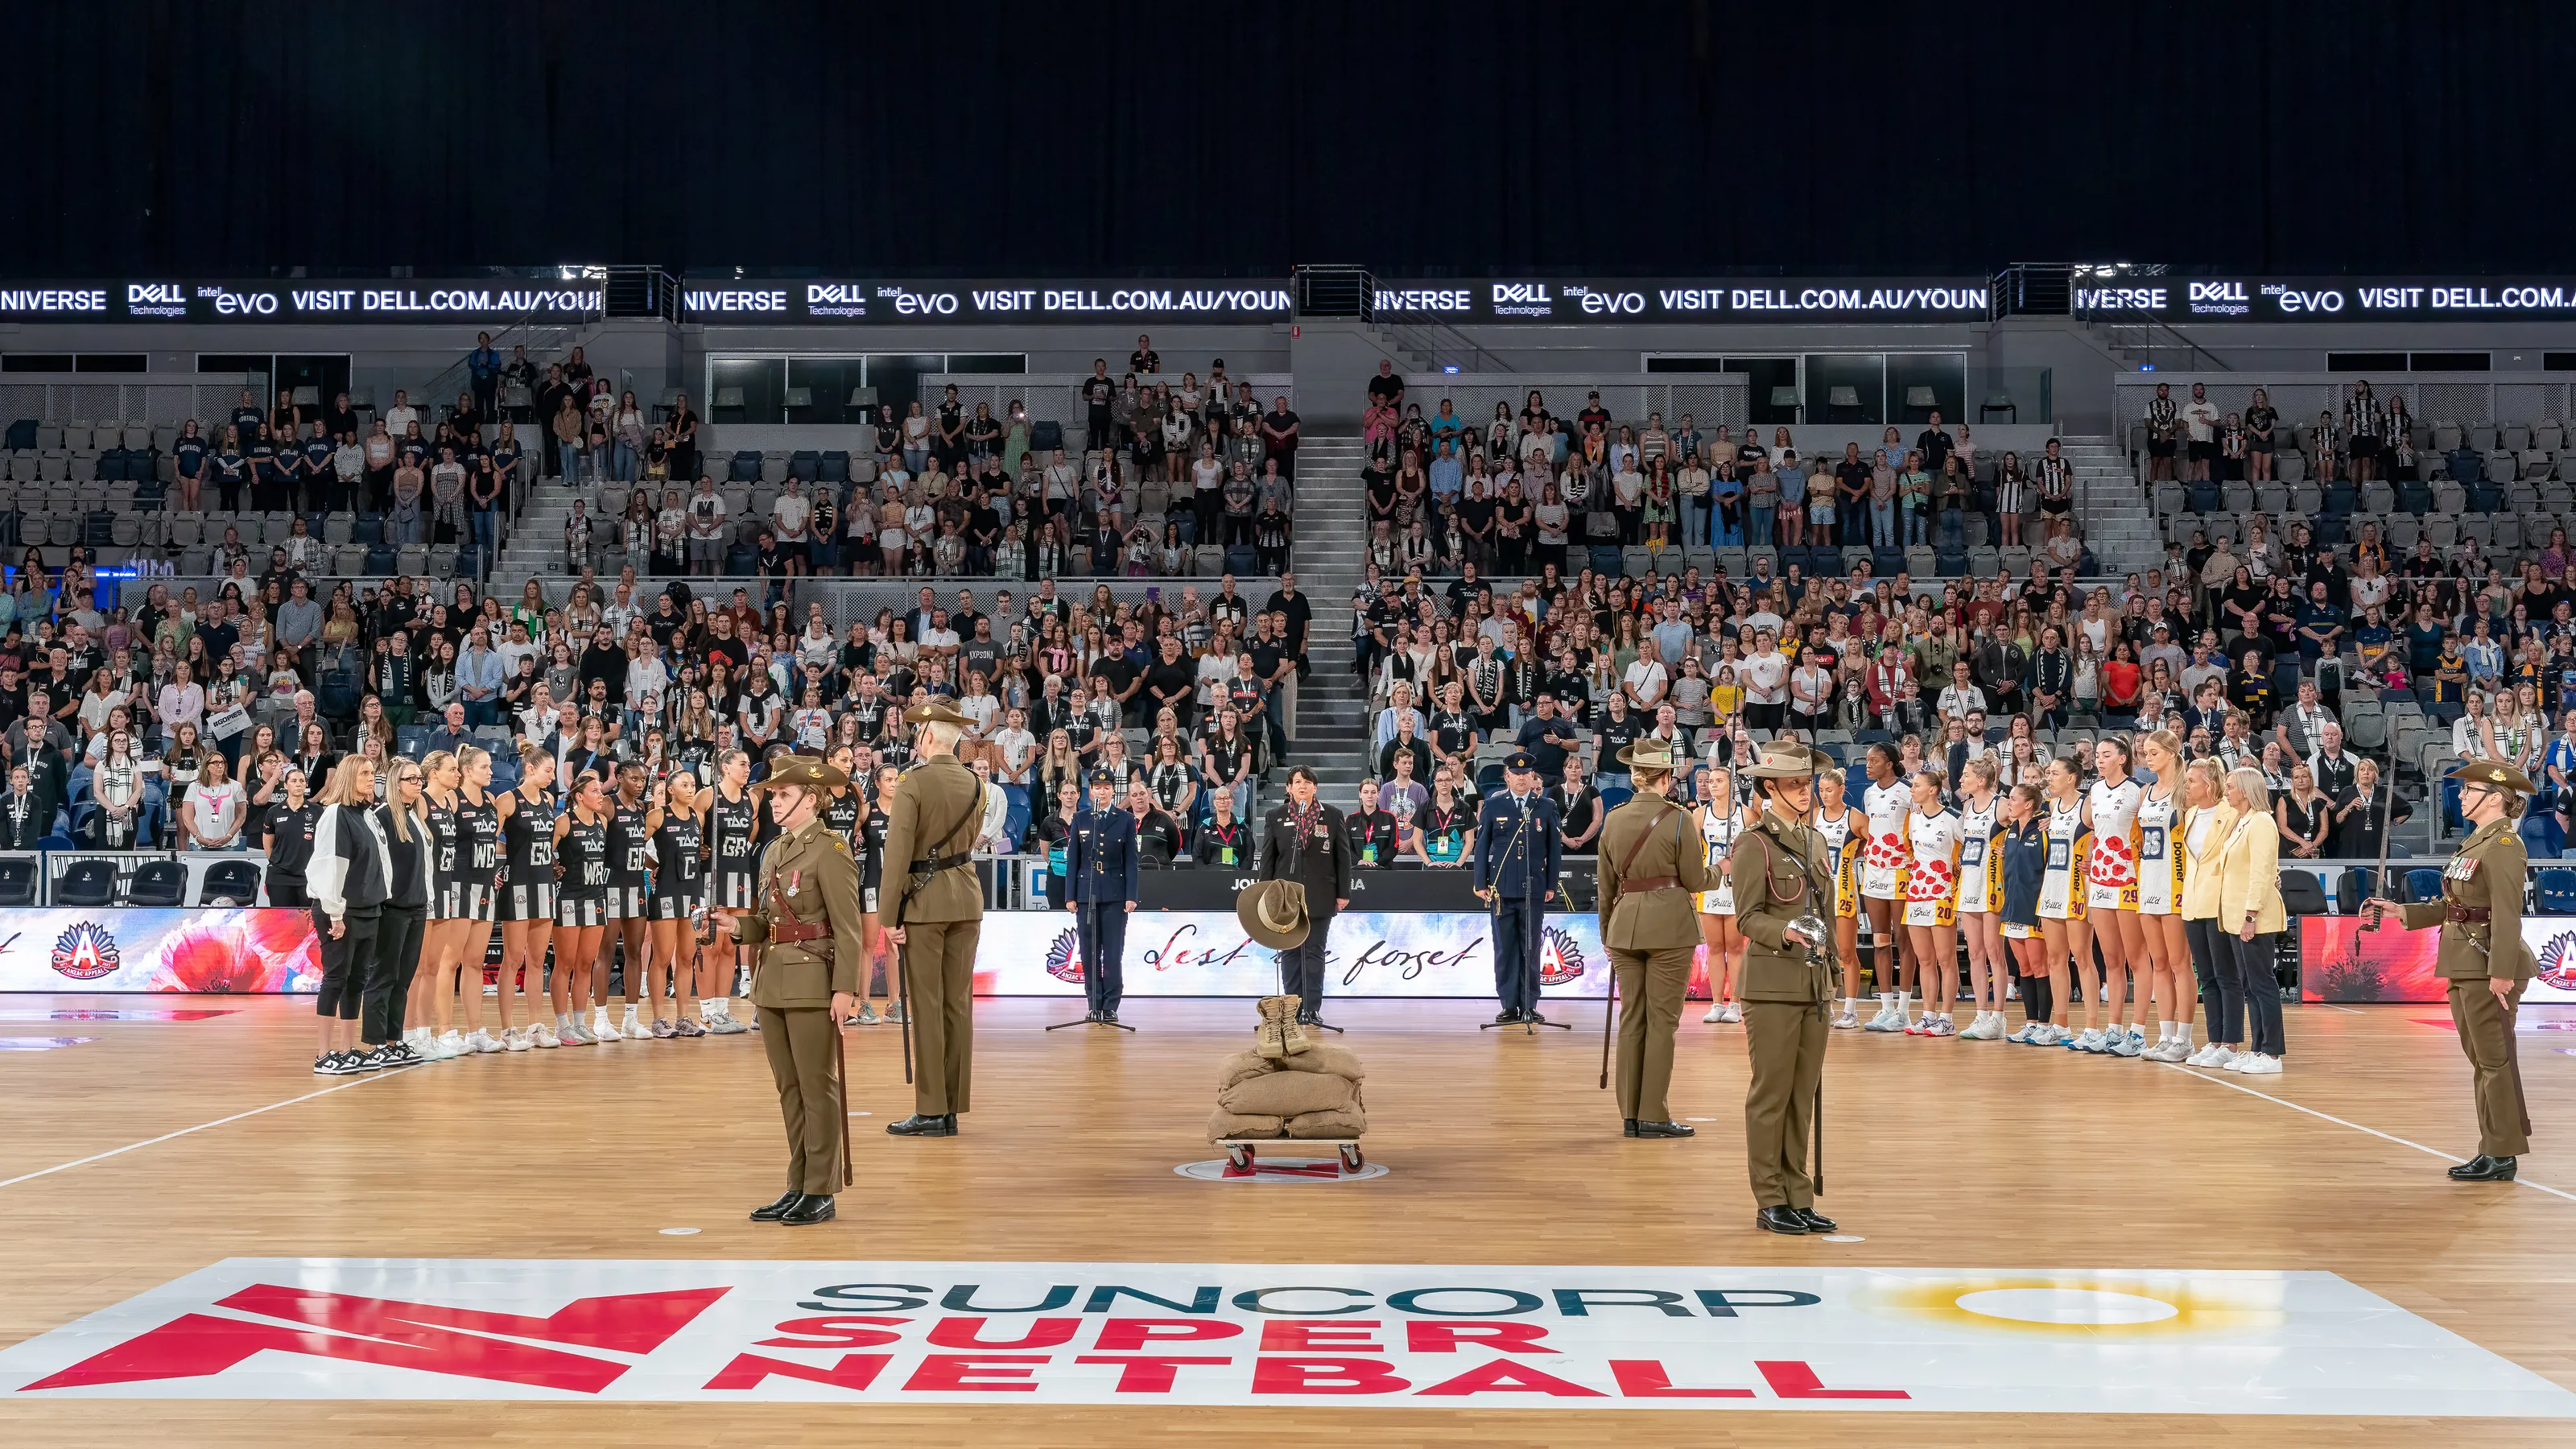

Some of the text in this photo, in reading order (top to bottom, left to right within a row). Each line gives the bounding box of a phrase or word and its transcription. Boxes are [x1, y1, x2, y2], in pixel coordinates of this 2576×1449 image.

[128, 284, 186, 303] DELL
[197, 286, 221, 297] intel
[807, 284, 865, 303] DELL
[877, 287, 902, 298] intel
[1492, 283, 1552, 302] DELL
[1563, 286, 1588, 297] intel
[2190, 282, 2248, 300] DELL
[2260, 284, 2286, 295] intel
[215, 293, 278, 314] evo
[291, 290, 356, 311] VISIT
[895, 293, 959, 314] evo
[972, 290, 1037, 311] VISIT
[1581, 292, 1645, 314] evo
[1659, 288, 1987, 310] VISIT DELL.COM.AU/YOUN
[2280, 291, 2344, 312] evo
[2359, 288, 2425, 308] VISIT
[129, 305, 186, 316] Technologies
[808, 305, 865, 316] Technologies
[1493, 305, 1551, 316] Technologies
[2190, 303, 2248, 315] Technologies
[829, 807, 855, 821] TAC
[473, 818, 497, 833] TAC
[531, 818, 554, 832] TAC
[724, 815, 749, 828] TAC
[582, 838, 604, 852] TAC
[676, 834, 700, 848] TAC
[473, 843, 496, 869] WD
[2173, 842, 2183, 883] Downer
[685, 856, 696, 880] C
[1842, 857, 1851, 891] Downer
[1899, 881, 1909, 894] 2
[1989, 894, 1998, 906] 9
[2123, 890, 2138, 904] 29
[1839, 899, 1853, 913] 25
[1937, 906, 1952, 920] 20
[2070, 901, 2085, 915] 30
[1144, 924, 1253, 972] Lest
[1343, 936, 1484, 986] forget
[66, 968, 105, 977] ANZAC APPEAL
[1062, 971, 1079, 980] ANZAC
[1546, 975, 1569, 984] APPEAL
[2552, 978, 2570, 988] ANZAC
[795, 1283, 1822, 1318] SUNCORP
[750, 1315, 1564, 1354] SUPER
[700, 1352, 1913, 1400] NETBALL
